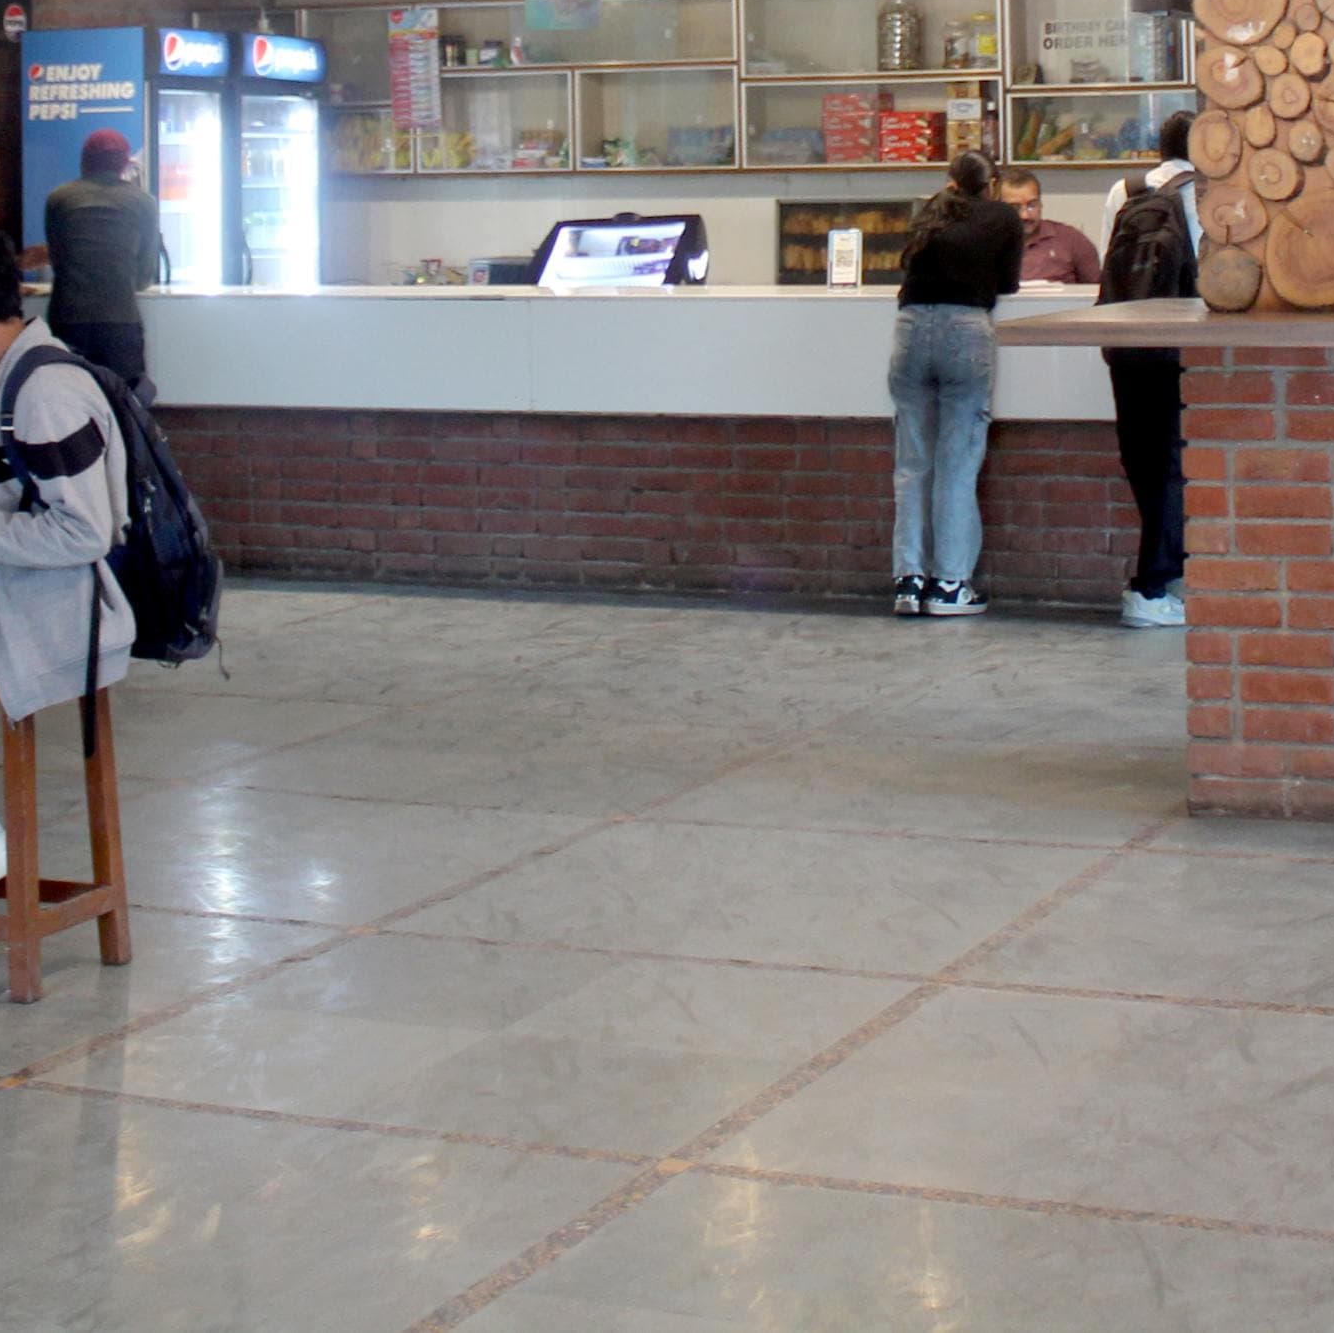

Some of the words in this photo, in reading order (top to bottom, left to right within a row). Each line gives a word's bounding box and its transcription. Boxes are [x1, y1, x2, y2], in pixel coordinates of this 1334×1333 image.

[1043, 36, 1093, 50] ORDER
[46, 64, 102, 82] ENJOY
[29, 82, 135, 101] REFRESHING
[29, 103, 78, 120] PEPSI
